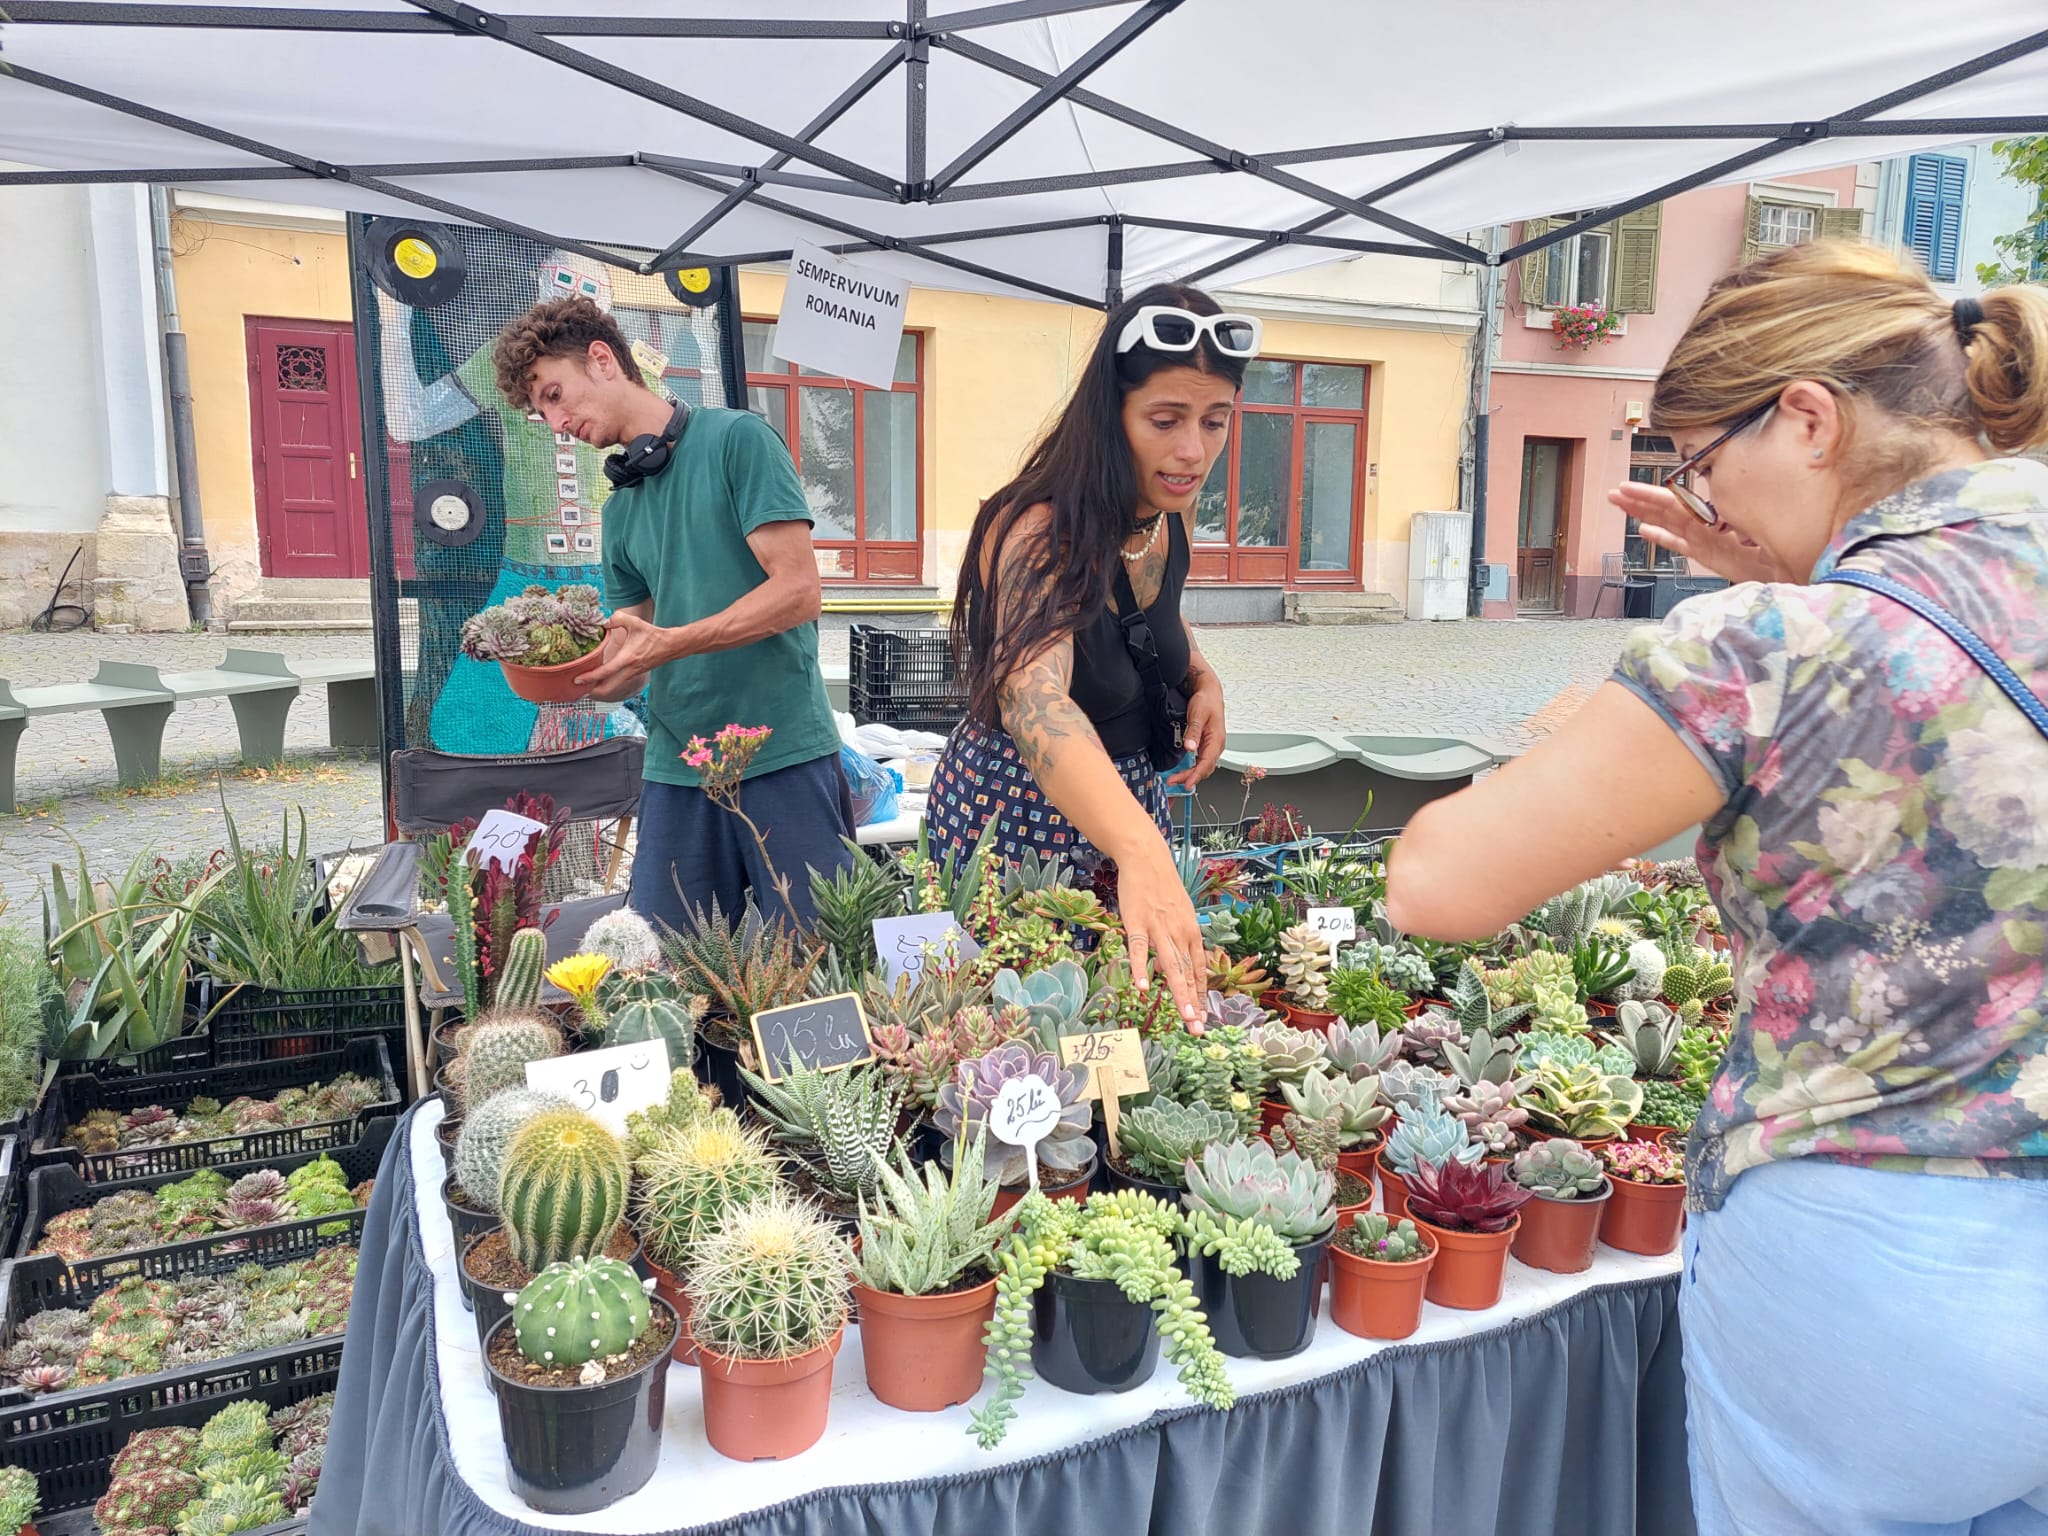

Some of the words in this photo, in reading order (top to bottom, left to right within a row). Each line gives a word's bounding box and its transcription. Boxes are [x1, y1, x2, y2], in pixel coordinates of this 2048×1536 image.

[797, 259, 900, 308] SEMPERVIVUM
[805, 294, 876, 330] ROMANIA
[496, 758, 546, 766] QUECHUA
[1317, 916, 1341, 931] 20
[771, 1011, 817, 1065] 25
[1006, 1092, 1027, 1125] 25
